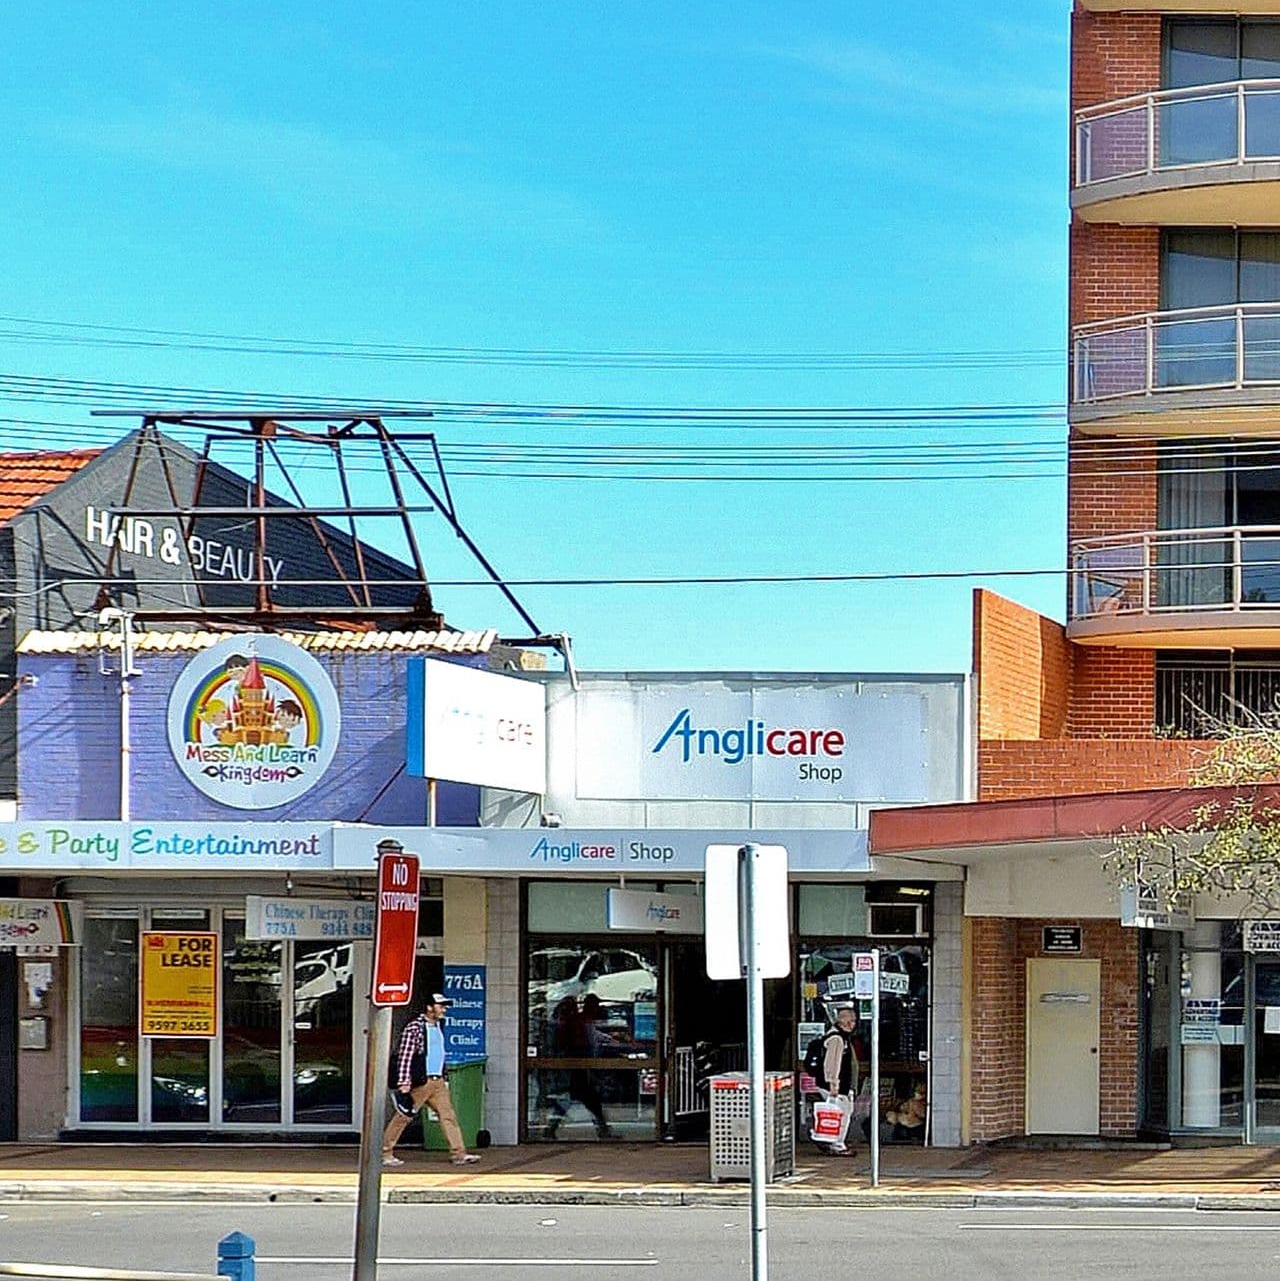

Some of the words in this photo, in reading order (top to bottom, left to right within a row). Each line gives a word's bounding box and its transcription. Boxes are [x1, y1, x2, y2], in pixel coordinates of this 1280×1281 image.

[84, 505, 154, 558] HAIR
[159, 527, 181, 566] &
[187, 534, 284, 589] BEAUY
[652, 708, 845, 764] Anglicare
[185, 745, 230, 762] Mess
[233, 744, 264, 762] And
[270, 744, 318, 763] Learn
[218, 764, 285, 785] Kingdom
[799, 763, 842, 784] Shop
[46, 829, 119, 861] Party
[131, 829, 321, 855] Entertainment
[530, 837, 615, 862] Anglicare
[630, 842, 674, 863] Shop
[392, 863, 408, 887] NO
[381, 891, 418, 912] STOPPING
[265, 903, 305, 919] Chinese
[309, 904, 349, 922] Therapy
[265, 922, 297, 935] 775A
[178, 937, 213, 952] FOR
[161, 953, 213, 968] LEASE
[446, 974, 484, 990] 775A
[148, 1020, 178, 1031] 9597
[445, 1017, 484, 1030] Therapy
[450, 1034, 480, 1046] Clinic
